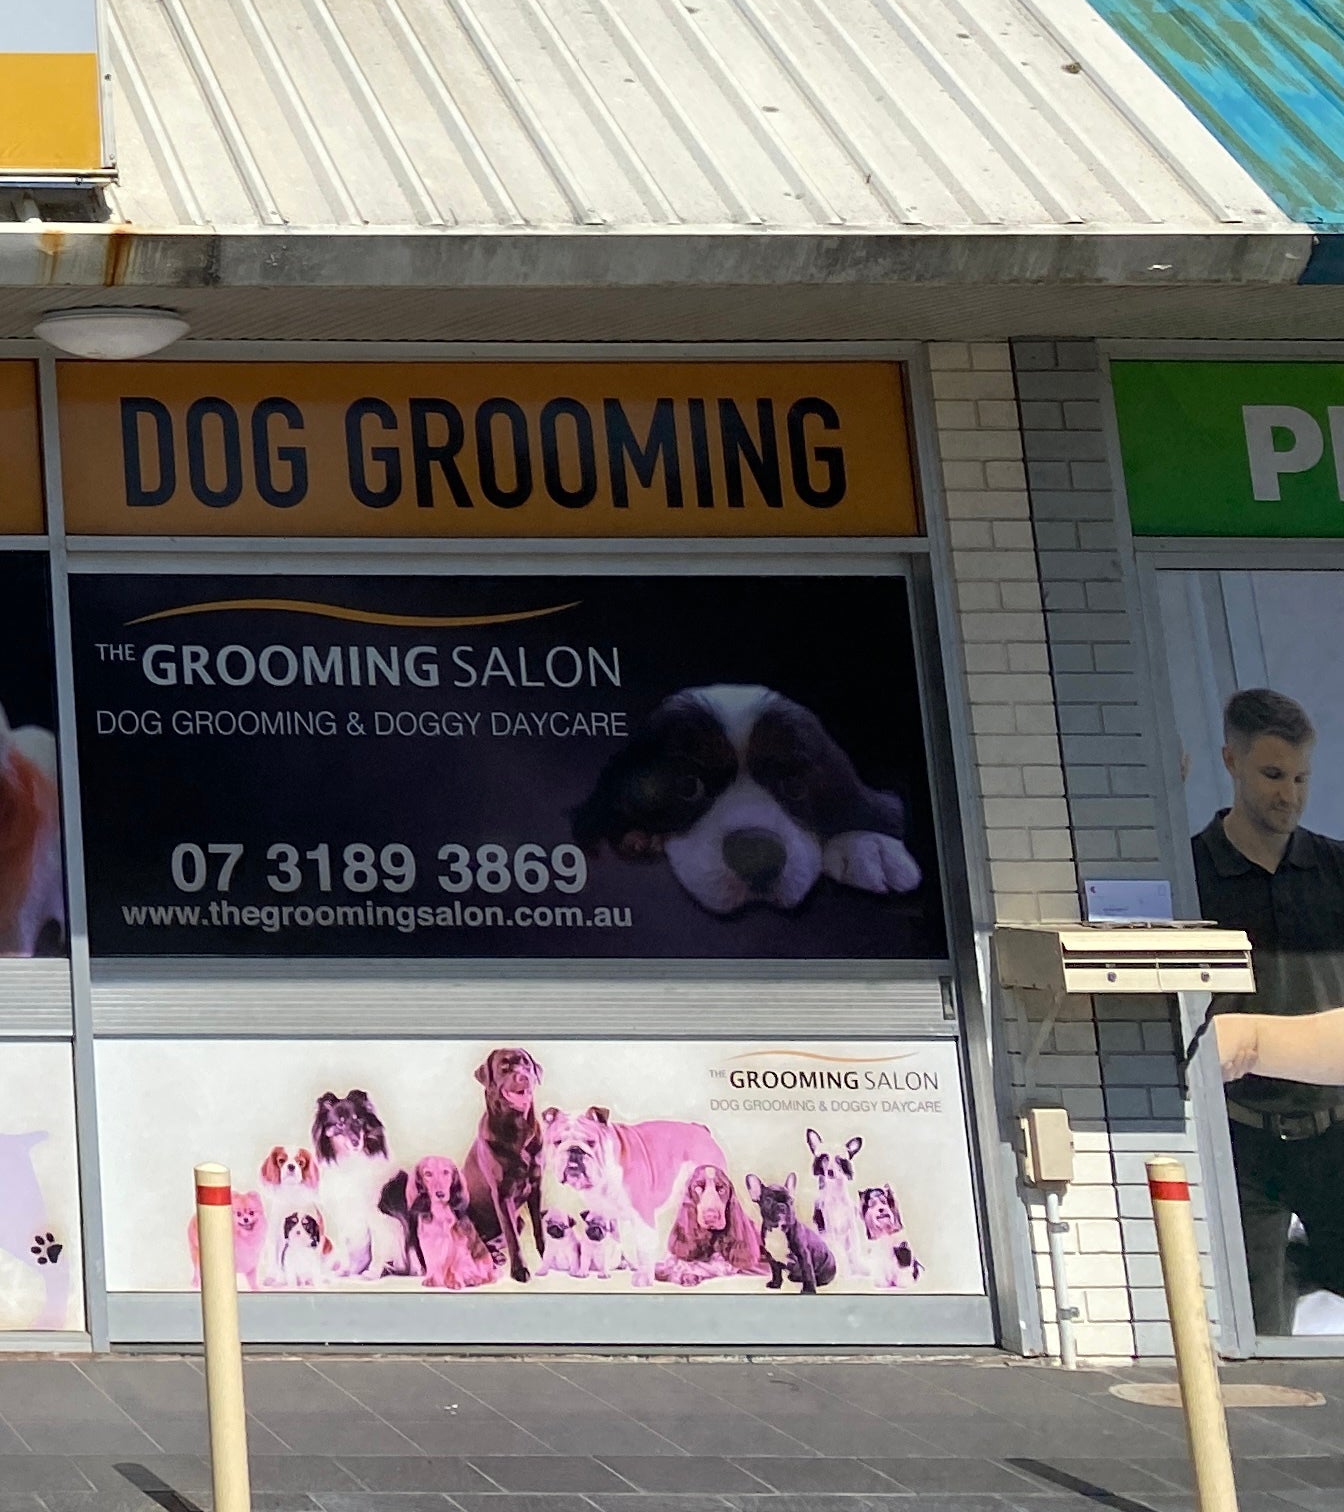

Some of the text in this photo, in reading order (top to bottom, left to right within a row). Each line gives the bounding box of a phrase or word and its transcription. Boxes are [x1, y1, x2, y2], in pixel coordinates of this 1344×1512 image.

[120, 395, 847, 510] DOG GROOMING
[95, 643, 622, 688] THE GROOMING SALON
[96, 710, 630, 738] DOG GROOMING & DOGGY DAYCARE
[170, 843, 588, 893] 07 3189 3869
[121, 900, 632, 930] www.thegroomingsalon.com.au
[709, 1069, 939, 1091] THE GROOMING SALON
[710, 1099, 943, 1113] DOG GROOMING & DOGGY DAYCARE
